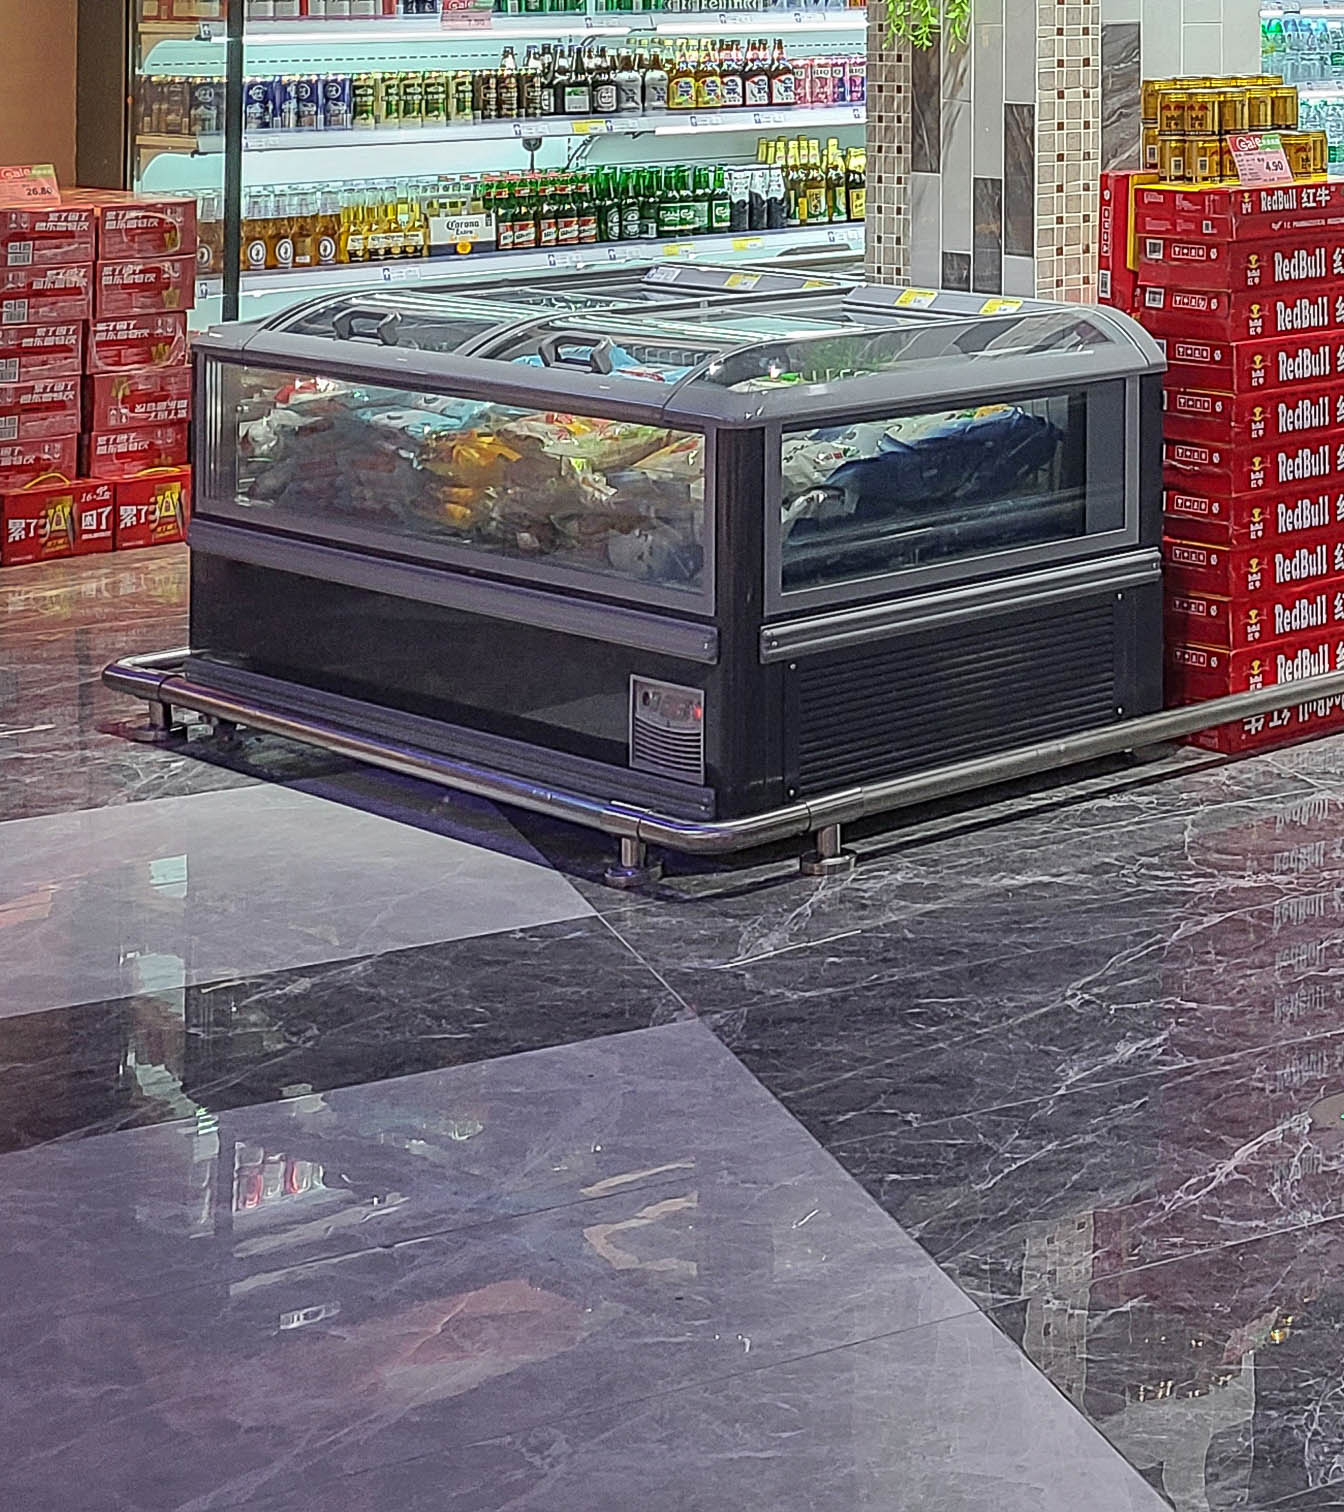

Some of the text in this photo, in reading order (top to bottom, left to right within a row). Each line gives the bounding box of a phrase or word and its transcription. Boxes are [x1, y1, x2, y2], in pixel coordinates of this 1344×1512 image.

[1265, 160, 1283, 172] 4.90
[1260, 189, 1296, 212] RedBull
[1301, 186, 1331, 208] 红牛
[1274, 248, 1326, 282] RedBull
[1276, 296, 1329, 331] RedBull
[1278, 346, 1330, 381] RedBull
[1278, 396, 1329, 433] RedBull
[1277, 445, 1330, 483] RedBull
[1277, 495, 1329, 533] RedBull
[1275, 544, 1327, 583] RedBull
[1274, 595, 1327, 634] RedBull
[1277, 644, 1329, 684] RedBull
